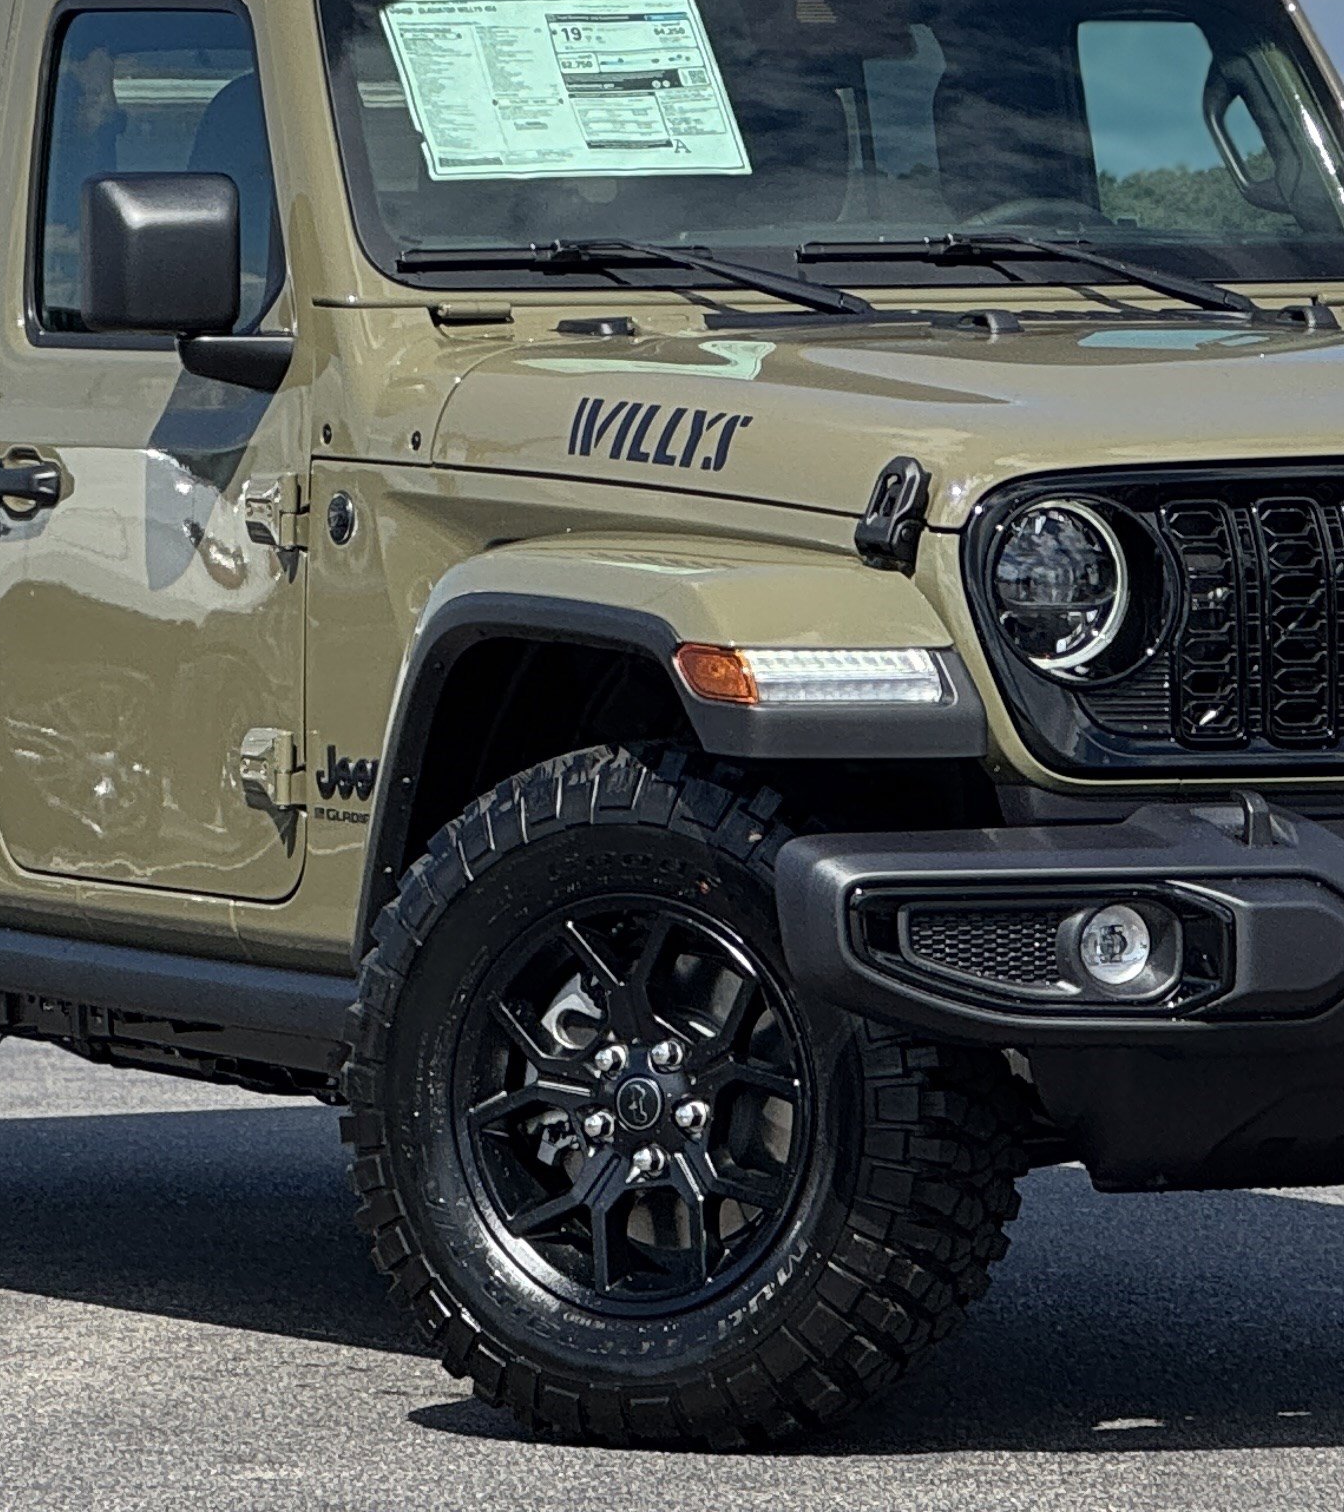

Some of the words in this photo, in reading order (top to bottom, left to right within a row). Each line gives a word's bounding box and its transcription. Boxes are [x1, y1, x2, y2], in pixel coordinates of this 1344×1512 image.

[561, 27, 583, 42] 19
[674, 138, 692, 154] A
[567, 396, 754, 472] WILLYS
